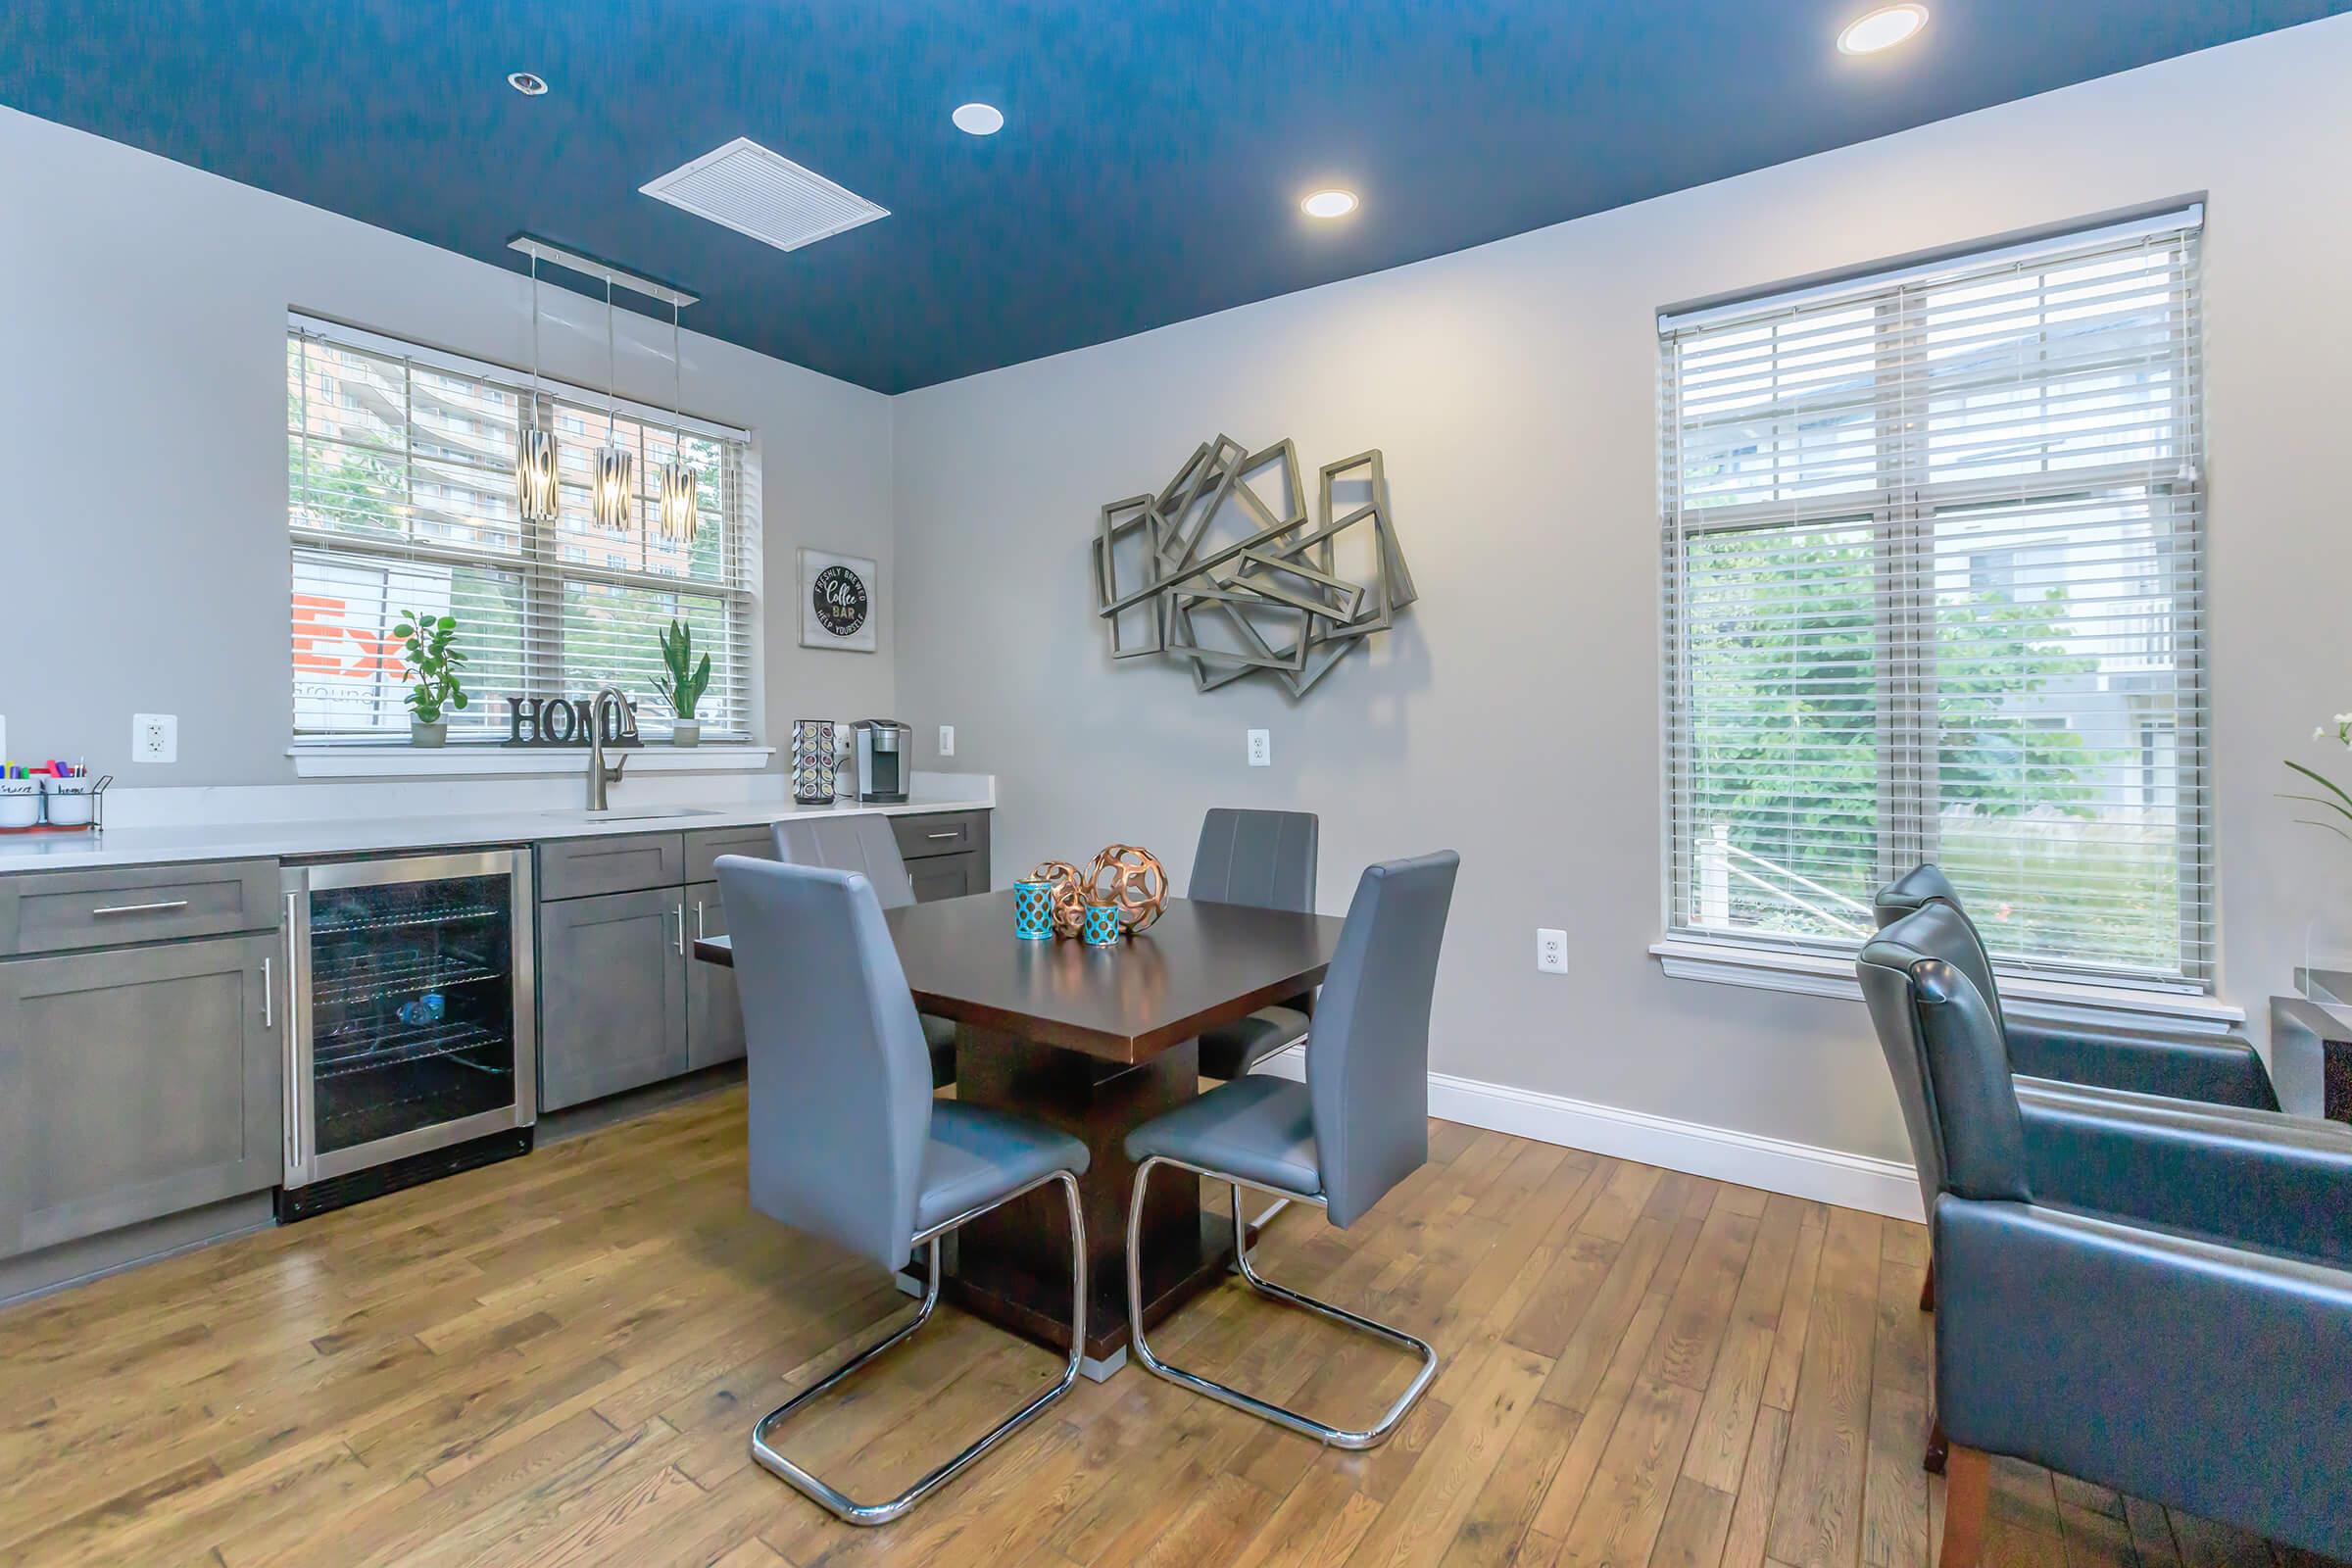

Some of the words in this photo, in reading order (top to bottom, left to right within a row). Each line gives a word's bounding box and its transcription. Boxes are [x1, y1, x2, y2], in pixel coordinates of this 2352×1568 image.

[815, 567, 842, 594] FRESHLY
[844, 570, 866, 602] BREWED
[824, 580, 858, 606] Coffee
[816, 610, 834, 629] HELP
[835, 612, 864, 635] YOURSELF
[832, 605, 856, 620] BAR
